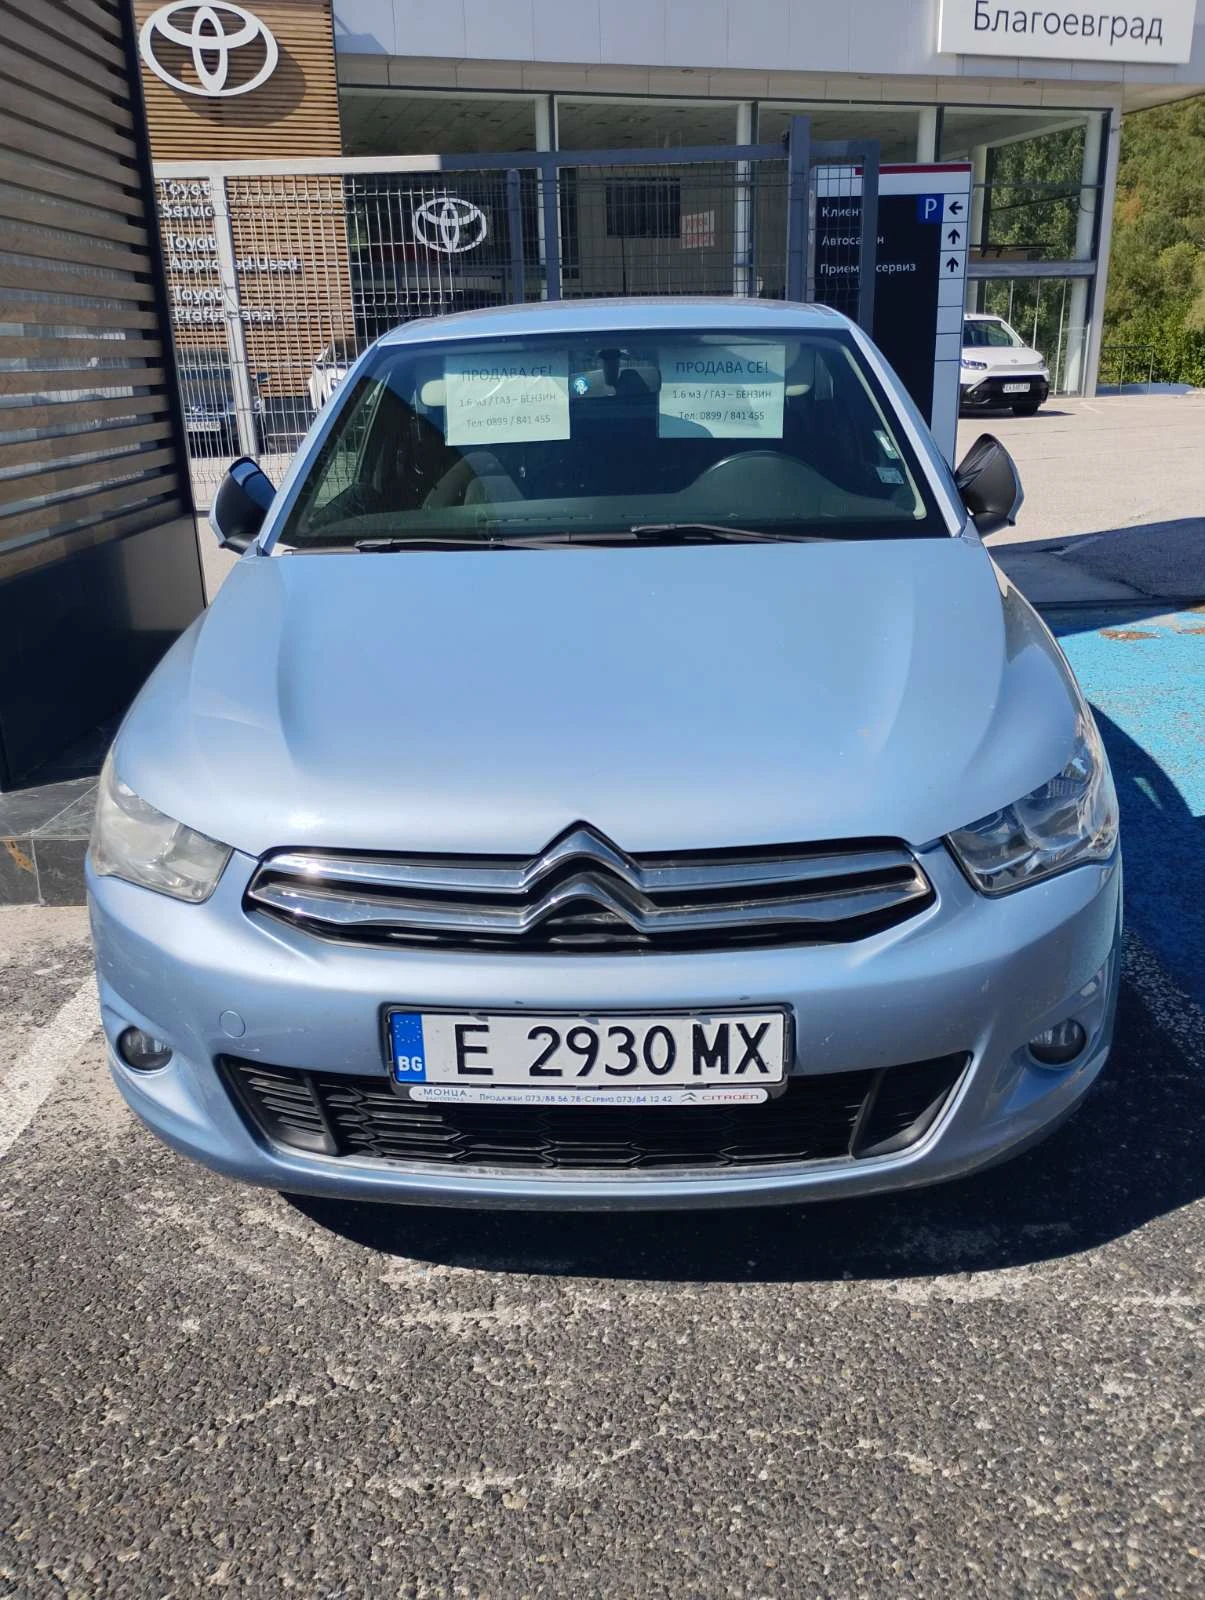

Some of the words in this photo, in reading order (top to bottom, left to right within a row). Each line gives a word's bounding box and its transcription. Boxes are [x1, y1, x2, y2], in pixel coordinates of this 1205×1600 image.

[973, 0, 1163, 46] Благоевград
[160, 179, 212, 199] Toyot
[162, 203, 215, 217] Servic
[924, 198, 938, 220] P
[166, 233, 217, 252] Toyot
[822, 235, 885, 246] Автосан
[170, 255, 253, 273] Approed
[257, 256, 299, 271] Used
[875, 263, 917, 275] сервиз
[173, 285, 225, 304] Toyot
[461, 366, 527, 383] ПРОДАВА
[531, 364, 553, 377] СЕ!
[675, 361, 744, 376] ПРОДАВА
[746, 361, 769, 374] СЕ!
[672, 390, 687, 399] 1.6
[710, 390, 726, 399] ГАЗ
[736, 389, 772, 399] БЕНЗИН
[516, 415, 532, 425] 841
[534, 414, 551, 424] 455
[700, 411, 722, 421] 0899
[730, 411, 746, 421] 841
[747, 411, 765, 421] 455
[454, 1024, 493, 1076] E
[527, 1024, 677, 1077] 2930
[692, 1022, 771, 1077] MX
[397, 1055, 423, 1072] BG
[423, 1088, 467, 1097] МОНЦА
[661, 1095, 673, 1103] 42
